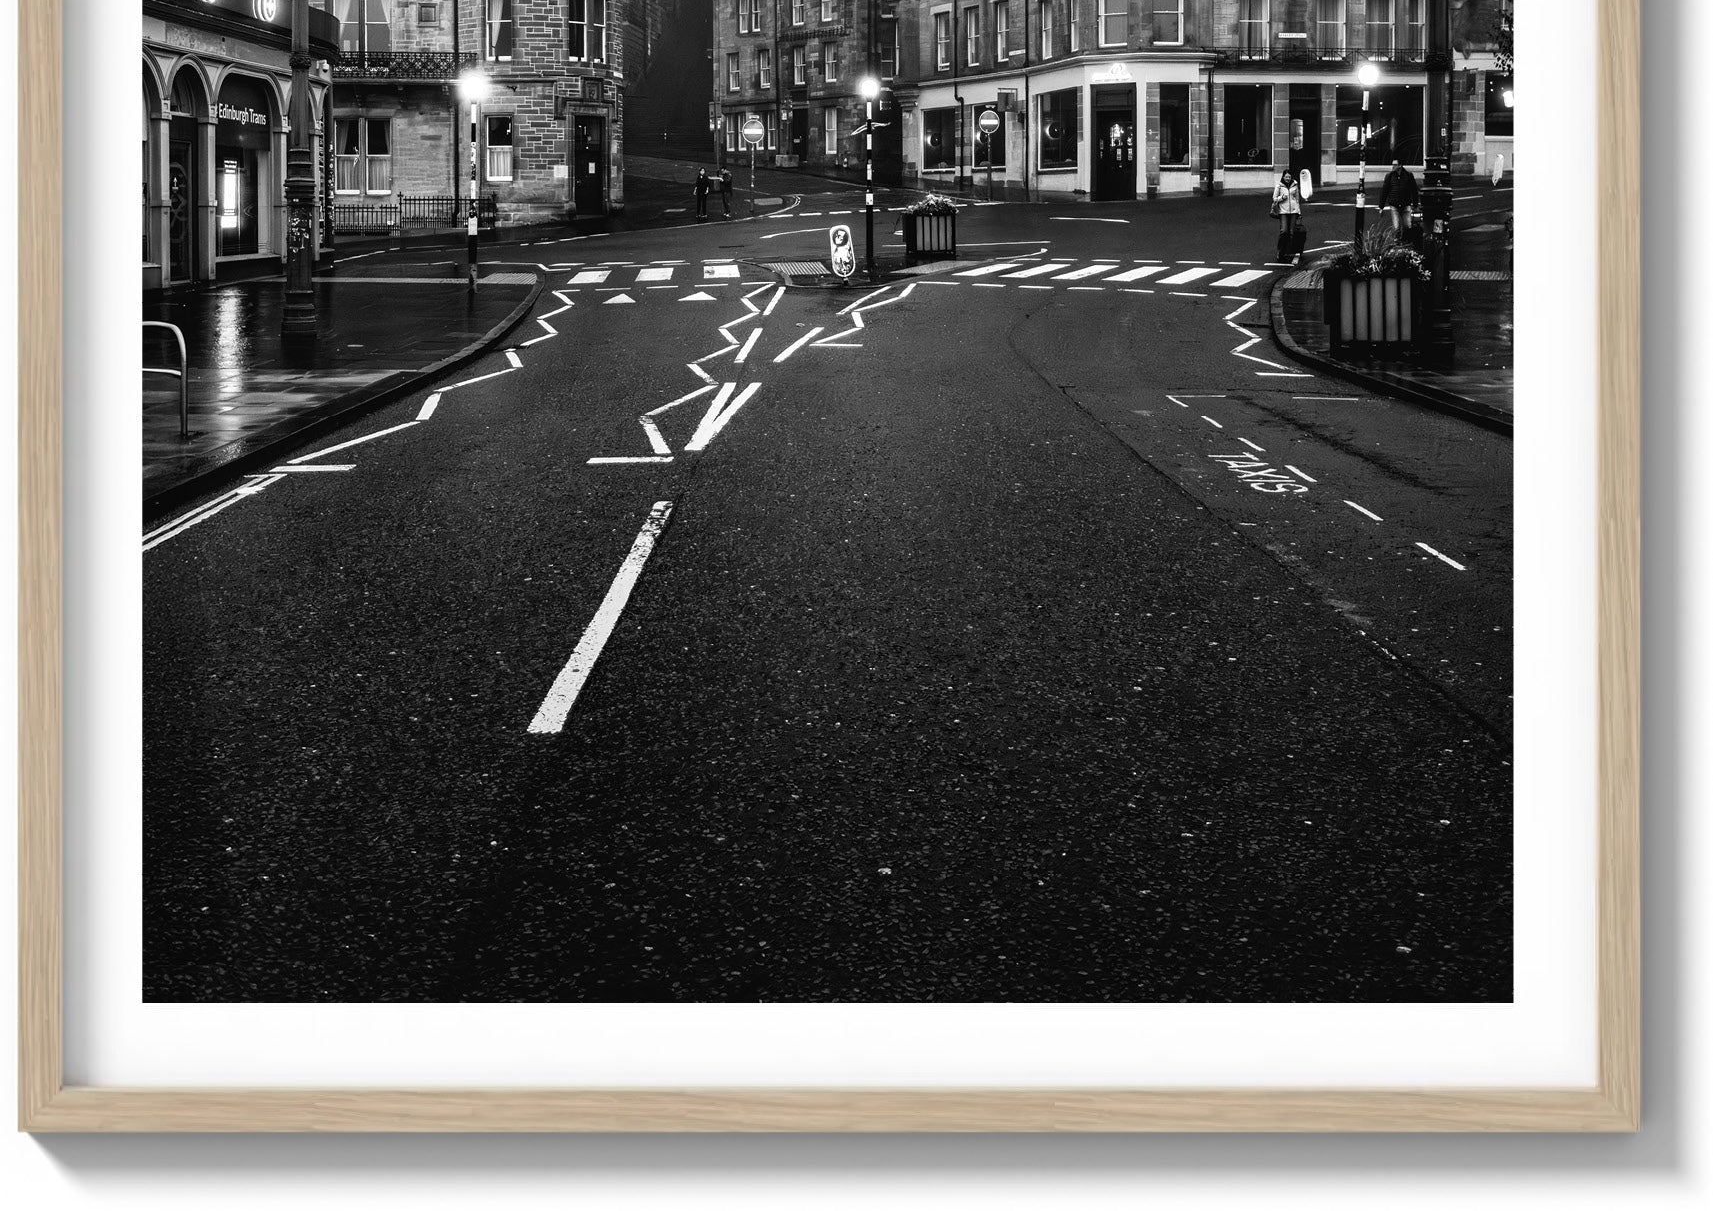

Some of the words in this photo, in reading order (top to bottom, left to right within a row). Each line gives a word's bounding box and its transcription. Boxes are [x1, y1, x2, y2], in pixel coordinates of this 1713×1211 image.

[219, 102, 249, 125] Edinburgh
[249, 108, 267, 125] Trams
[1207, 451, 1309, 493] TAXIS
